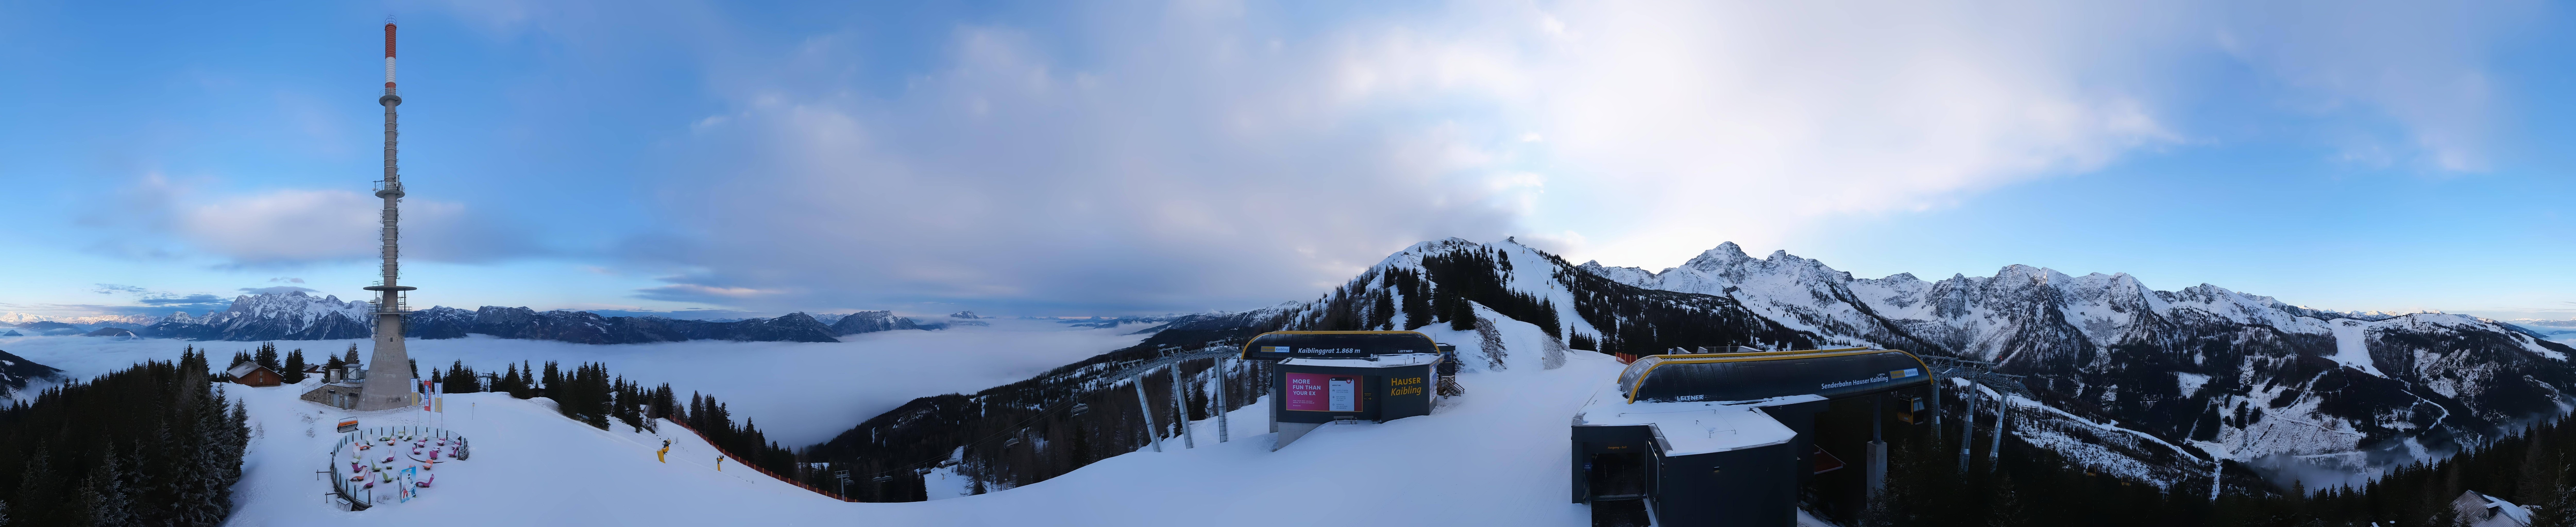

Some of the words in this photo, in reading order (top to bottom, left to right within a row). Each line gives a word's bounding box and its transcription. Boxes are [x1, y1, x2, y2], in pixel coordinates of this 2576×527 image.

[1391, 377, 1421, 386] HAUSER
[1821, 380, 1852, 389] Senderbahn
[1391, 386, 1421, 396] Kaibling
